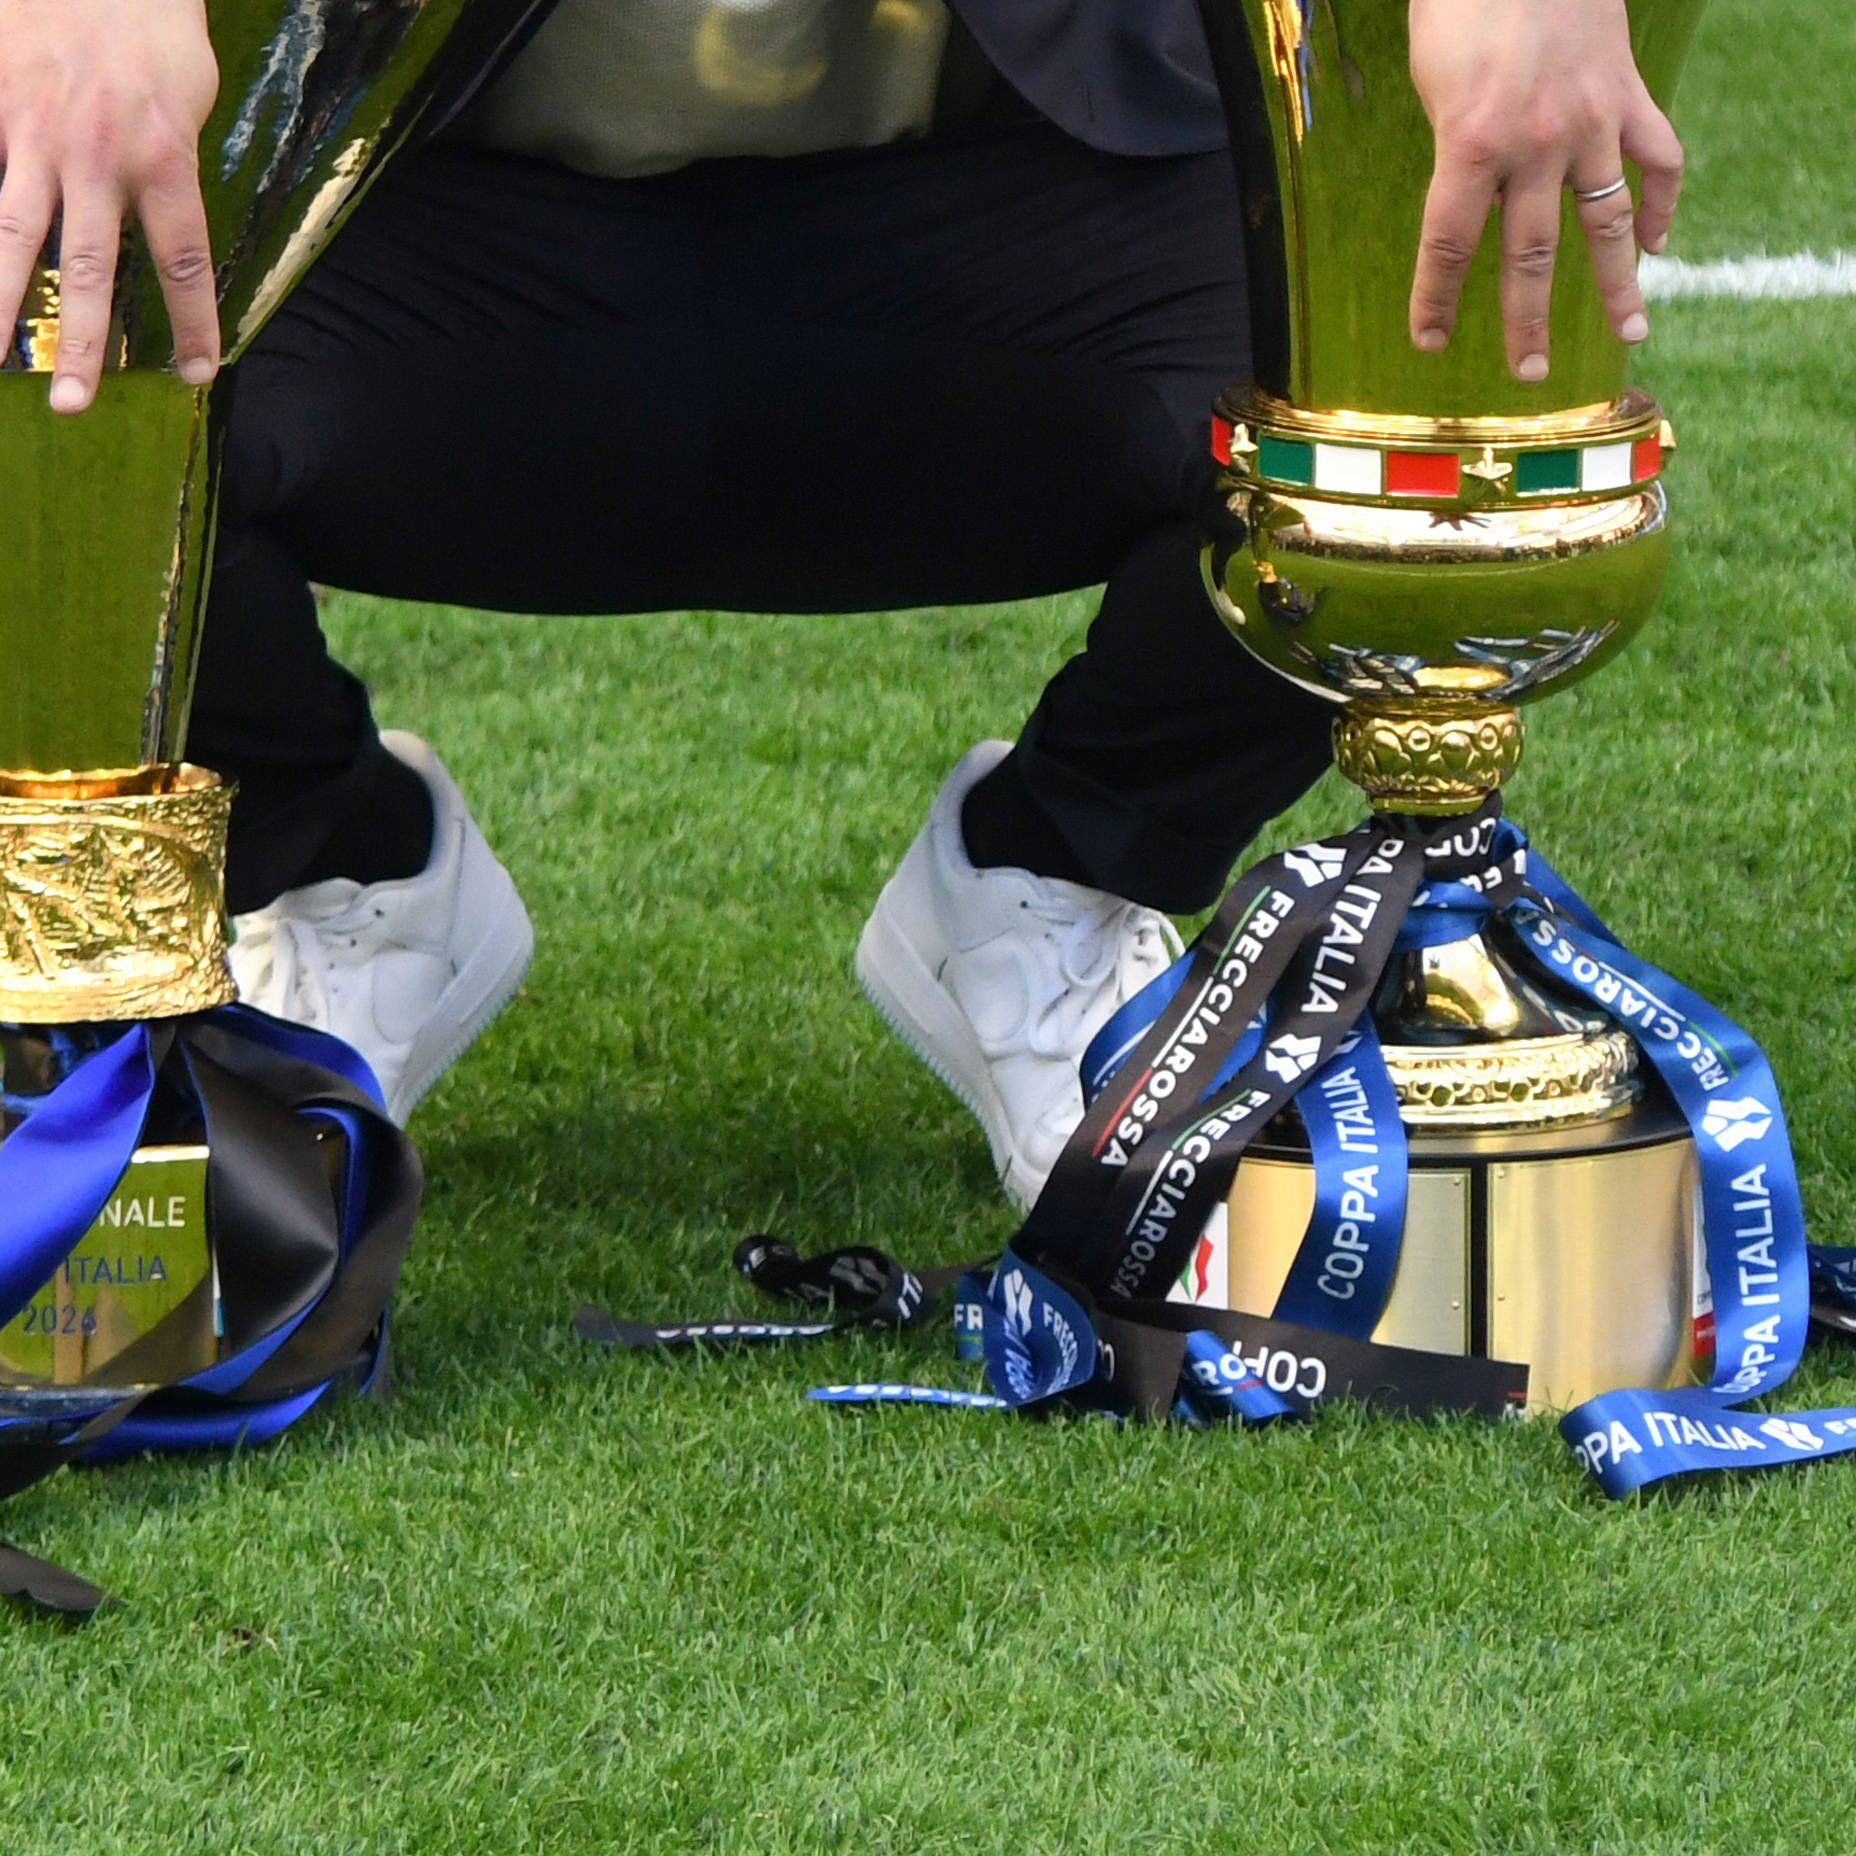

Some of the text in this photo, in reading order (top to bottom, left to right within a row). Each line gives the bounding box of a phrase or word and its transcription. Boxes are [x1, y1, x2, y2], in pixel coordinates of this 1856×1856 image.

[1301, 884, 1383, 1014] ITALIA
[1101, 890, 1295, 1166] FRECCIAROSSA
[1109, 1090, 1271, 1298] FRECCIAROSSA
[1317, 1066, 1379, 1300] COPPA ITALIA
[1730, 1163, 1780, 1307] ITALIA
[63, 1255, 168, 1286] ITALIA
[1644, 1411, 1767, 1451] ITALIA
